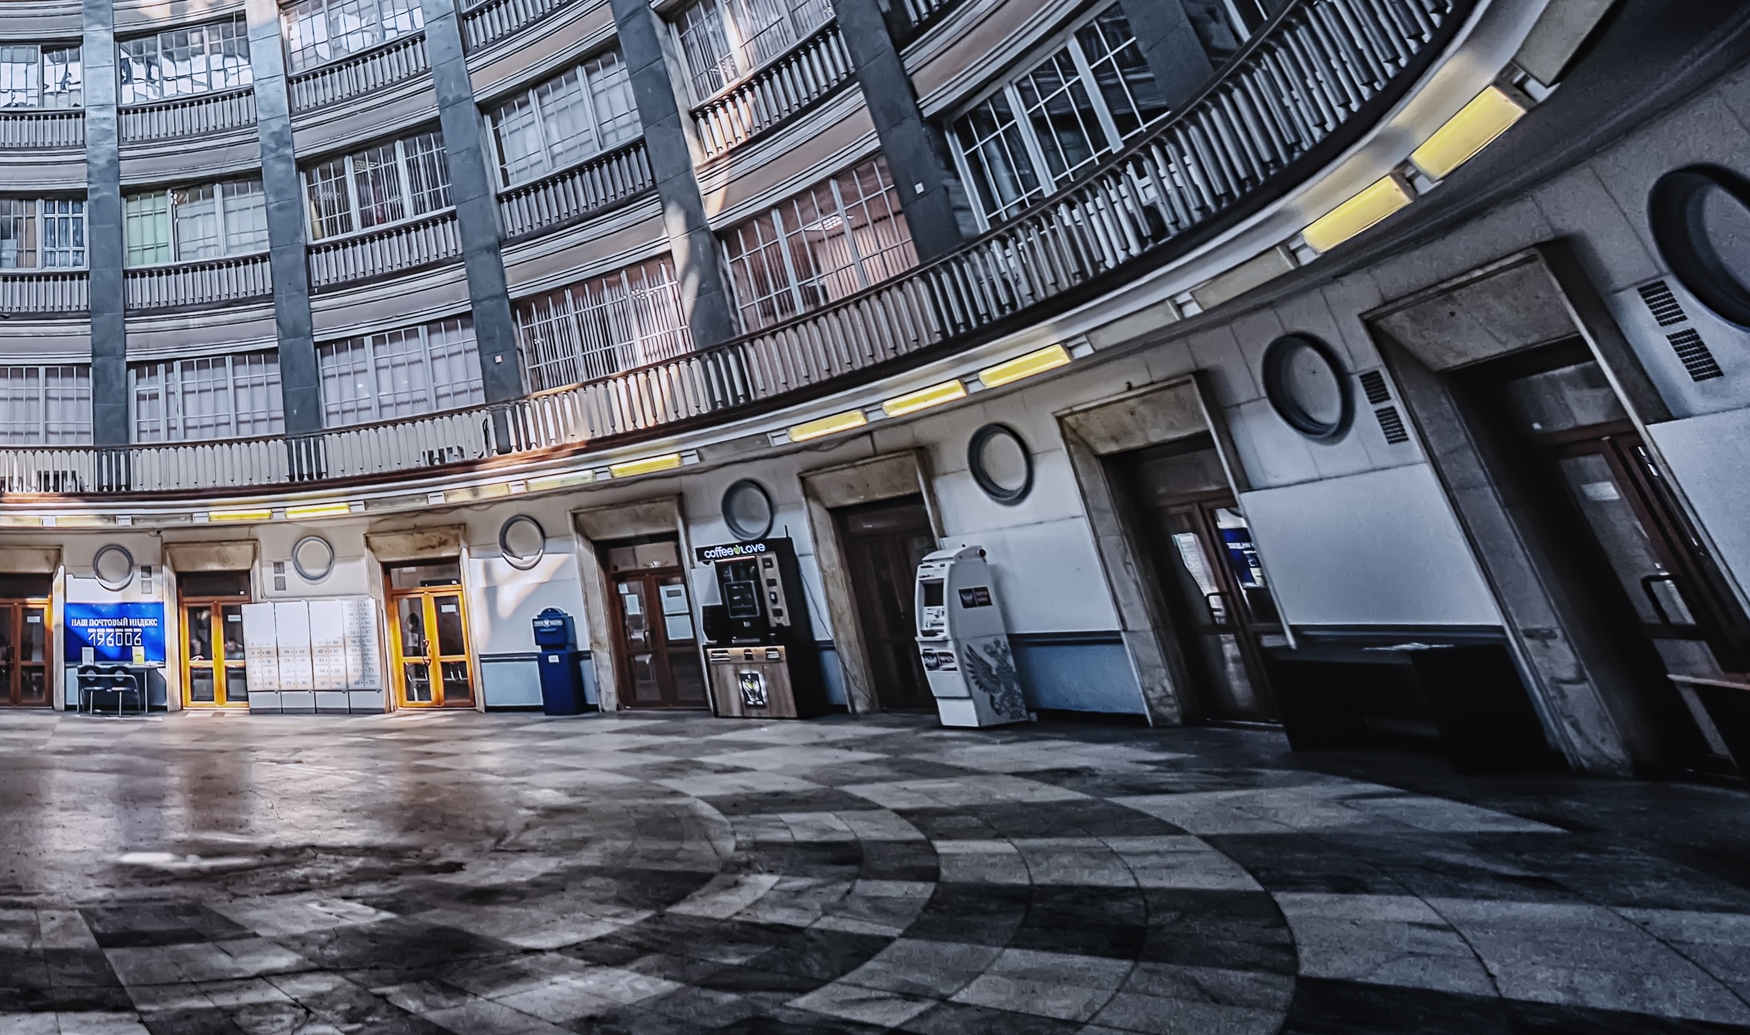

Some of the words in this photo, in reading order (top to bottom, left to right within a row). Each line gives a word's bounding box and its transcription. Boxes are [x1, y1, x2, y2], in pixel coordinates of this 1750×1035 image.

[704, 545, 734, 559] coffee
[71, 618, 88, 627] НАШ
[88, 617, 129, 627] ПОЧТОВЫЙ
[129, 618, 158, 628] ИНДЕКС
[88, 631, 142, 646] 196006
